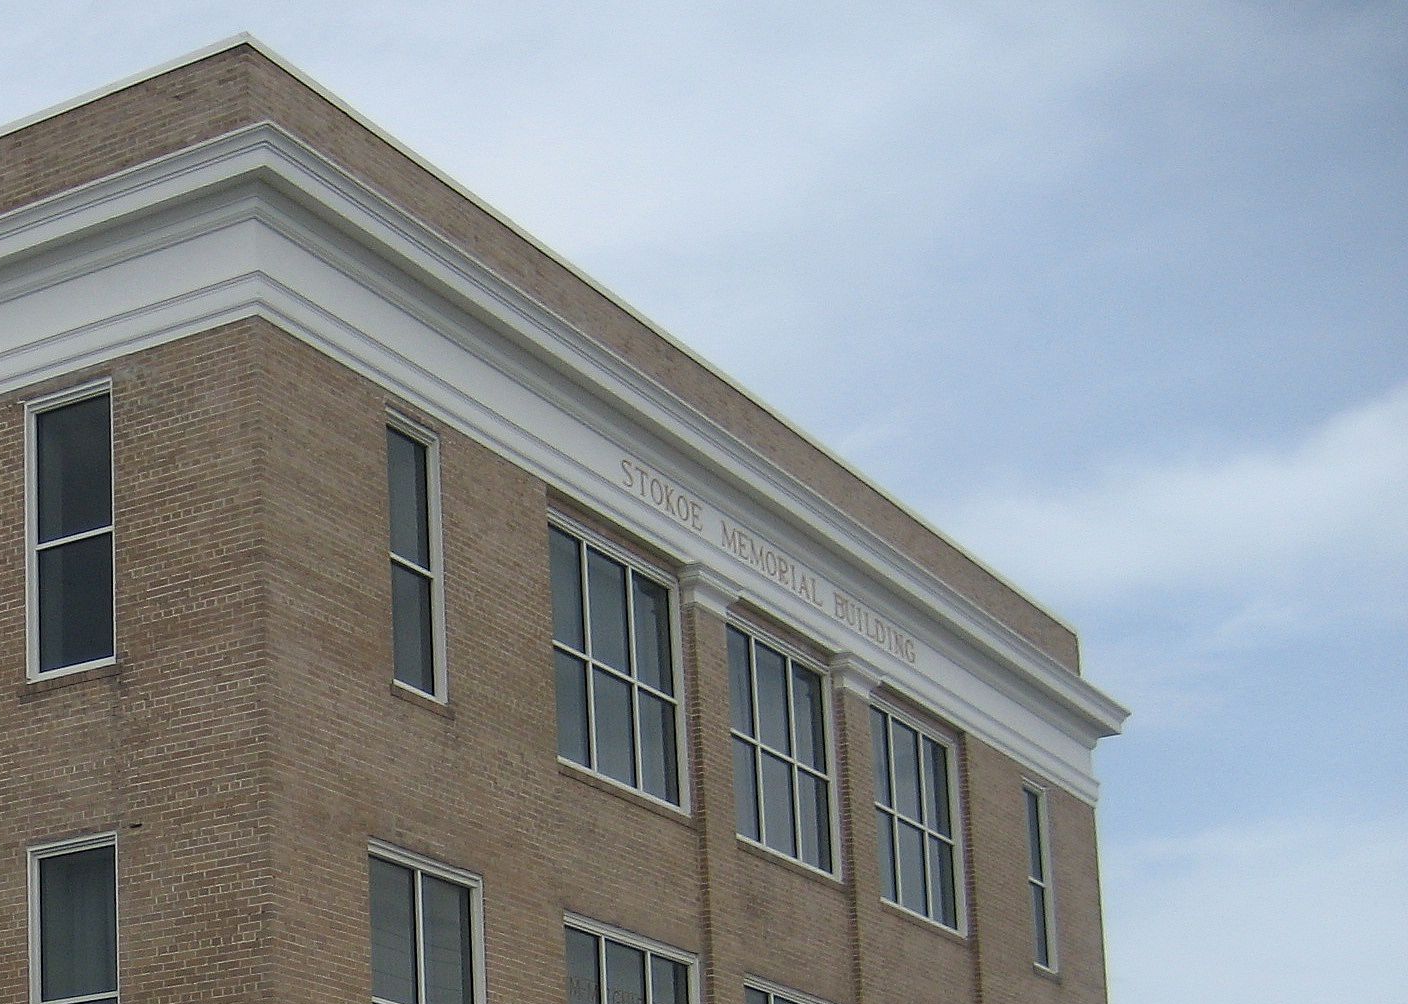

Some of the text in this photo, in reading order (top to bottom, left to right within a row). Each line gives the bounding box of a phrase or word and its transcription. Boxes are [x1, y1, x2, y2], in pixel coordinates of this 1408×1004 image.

[619, 459, 917, 664] STOKOE MEMORIAL BUILDING
